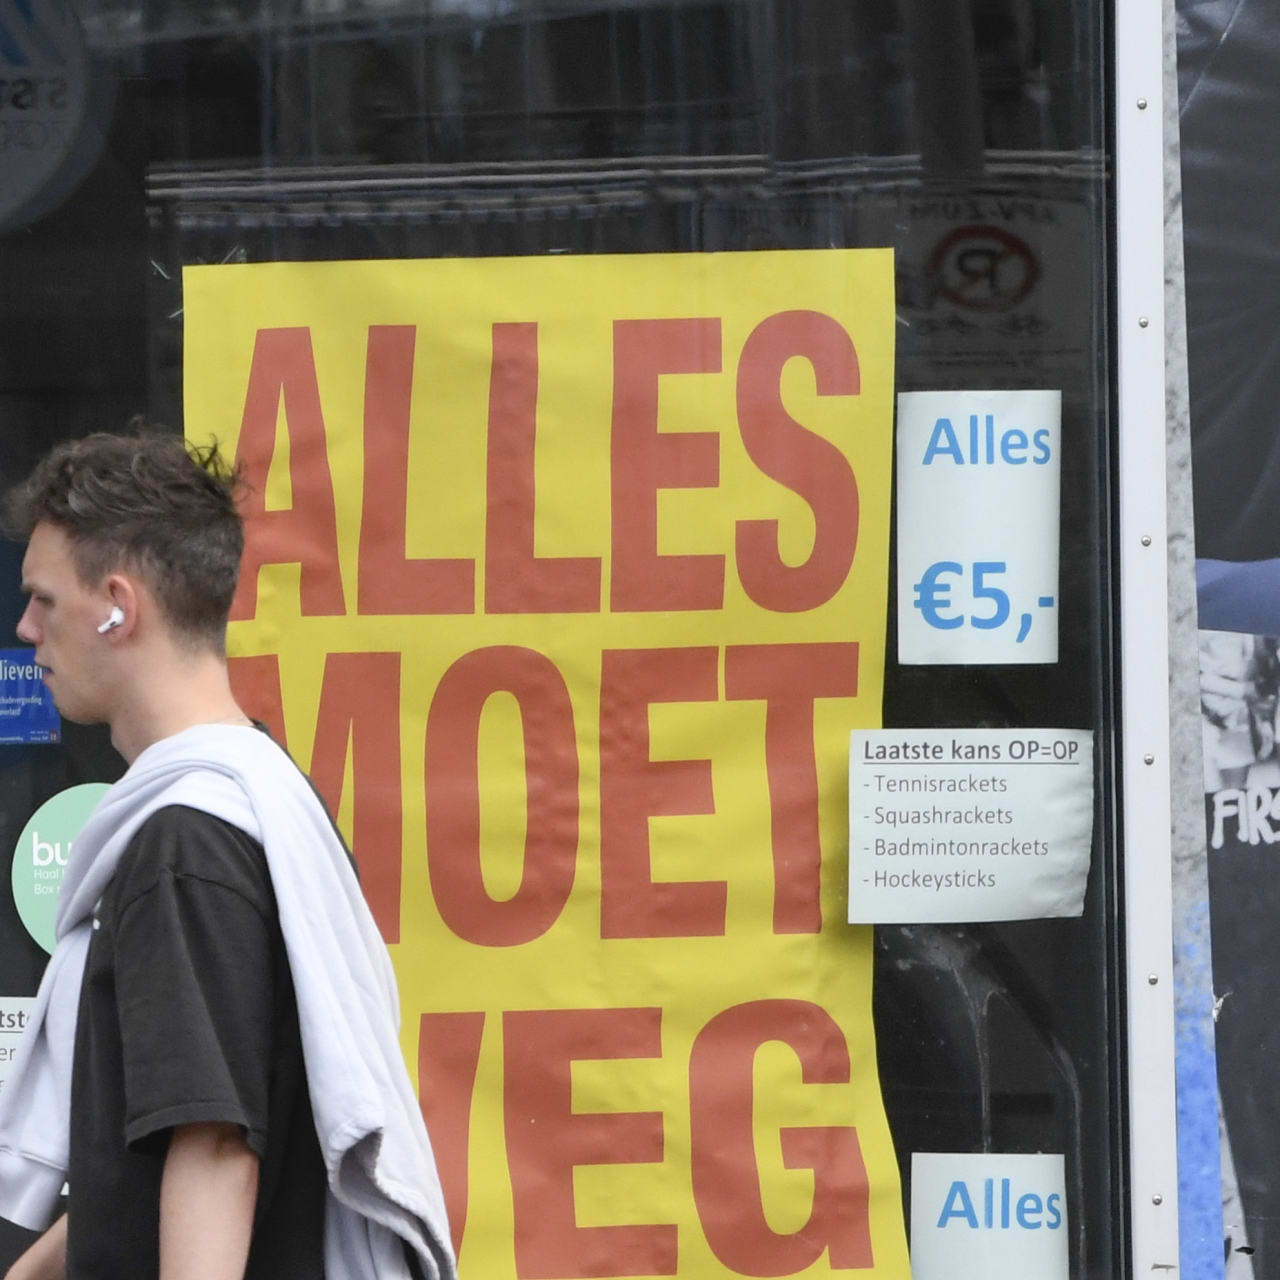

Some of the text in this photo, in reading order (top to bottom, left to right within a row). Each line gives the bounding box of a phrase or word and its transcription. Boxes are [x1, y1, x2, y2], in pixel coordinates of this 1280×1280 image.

[921, 415, 1052, 466] Alles
[227, 309, 861, 623] ALLES
[913, 561, 1056, 643] €5,-
[864, 739, 1079, 761] Laatste kans OP=OP
[874, 774, 1008, 793] Tennisrackets
[874, 806, 1013, 828] Squashrackets
[875, 838, 1049, 856] Badmintonrackets
[874, 869, 996, 892] Hockeysticks
[936, 1178, 1063, 1230] Alles
